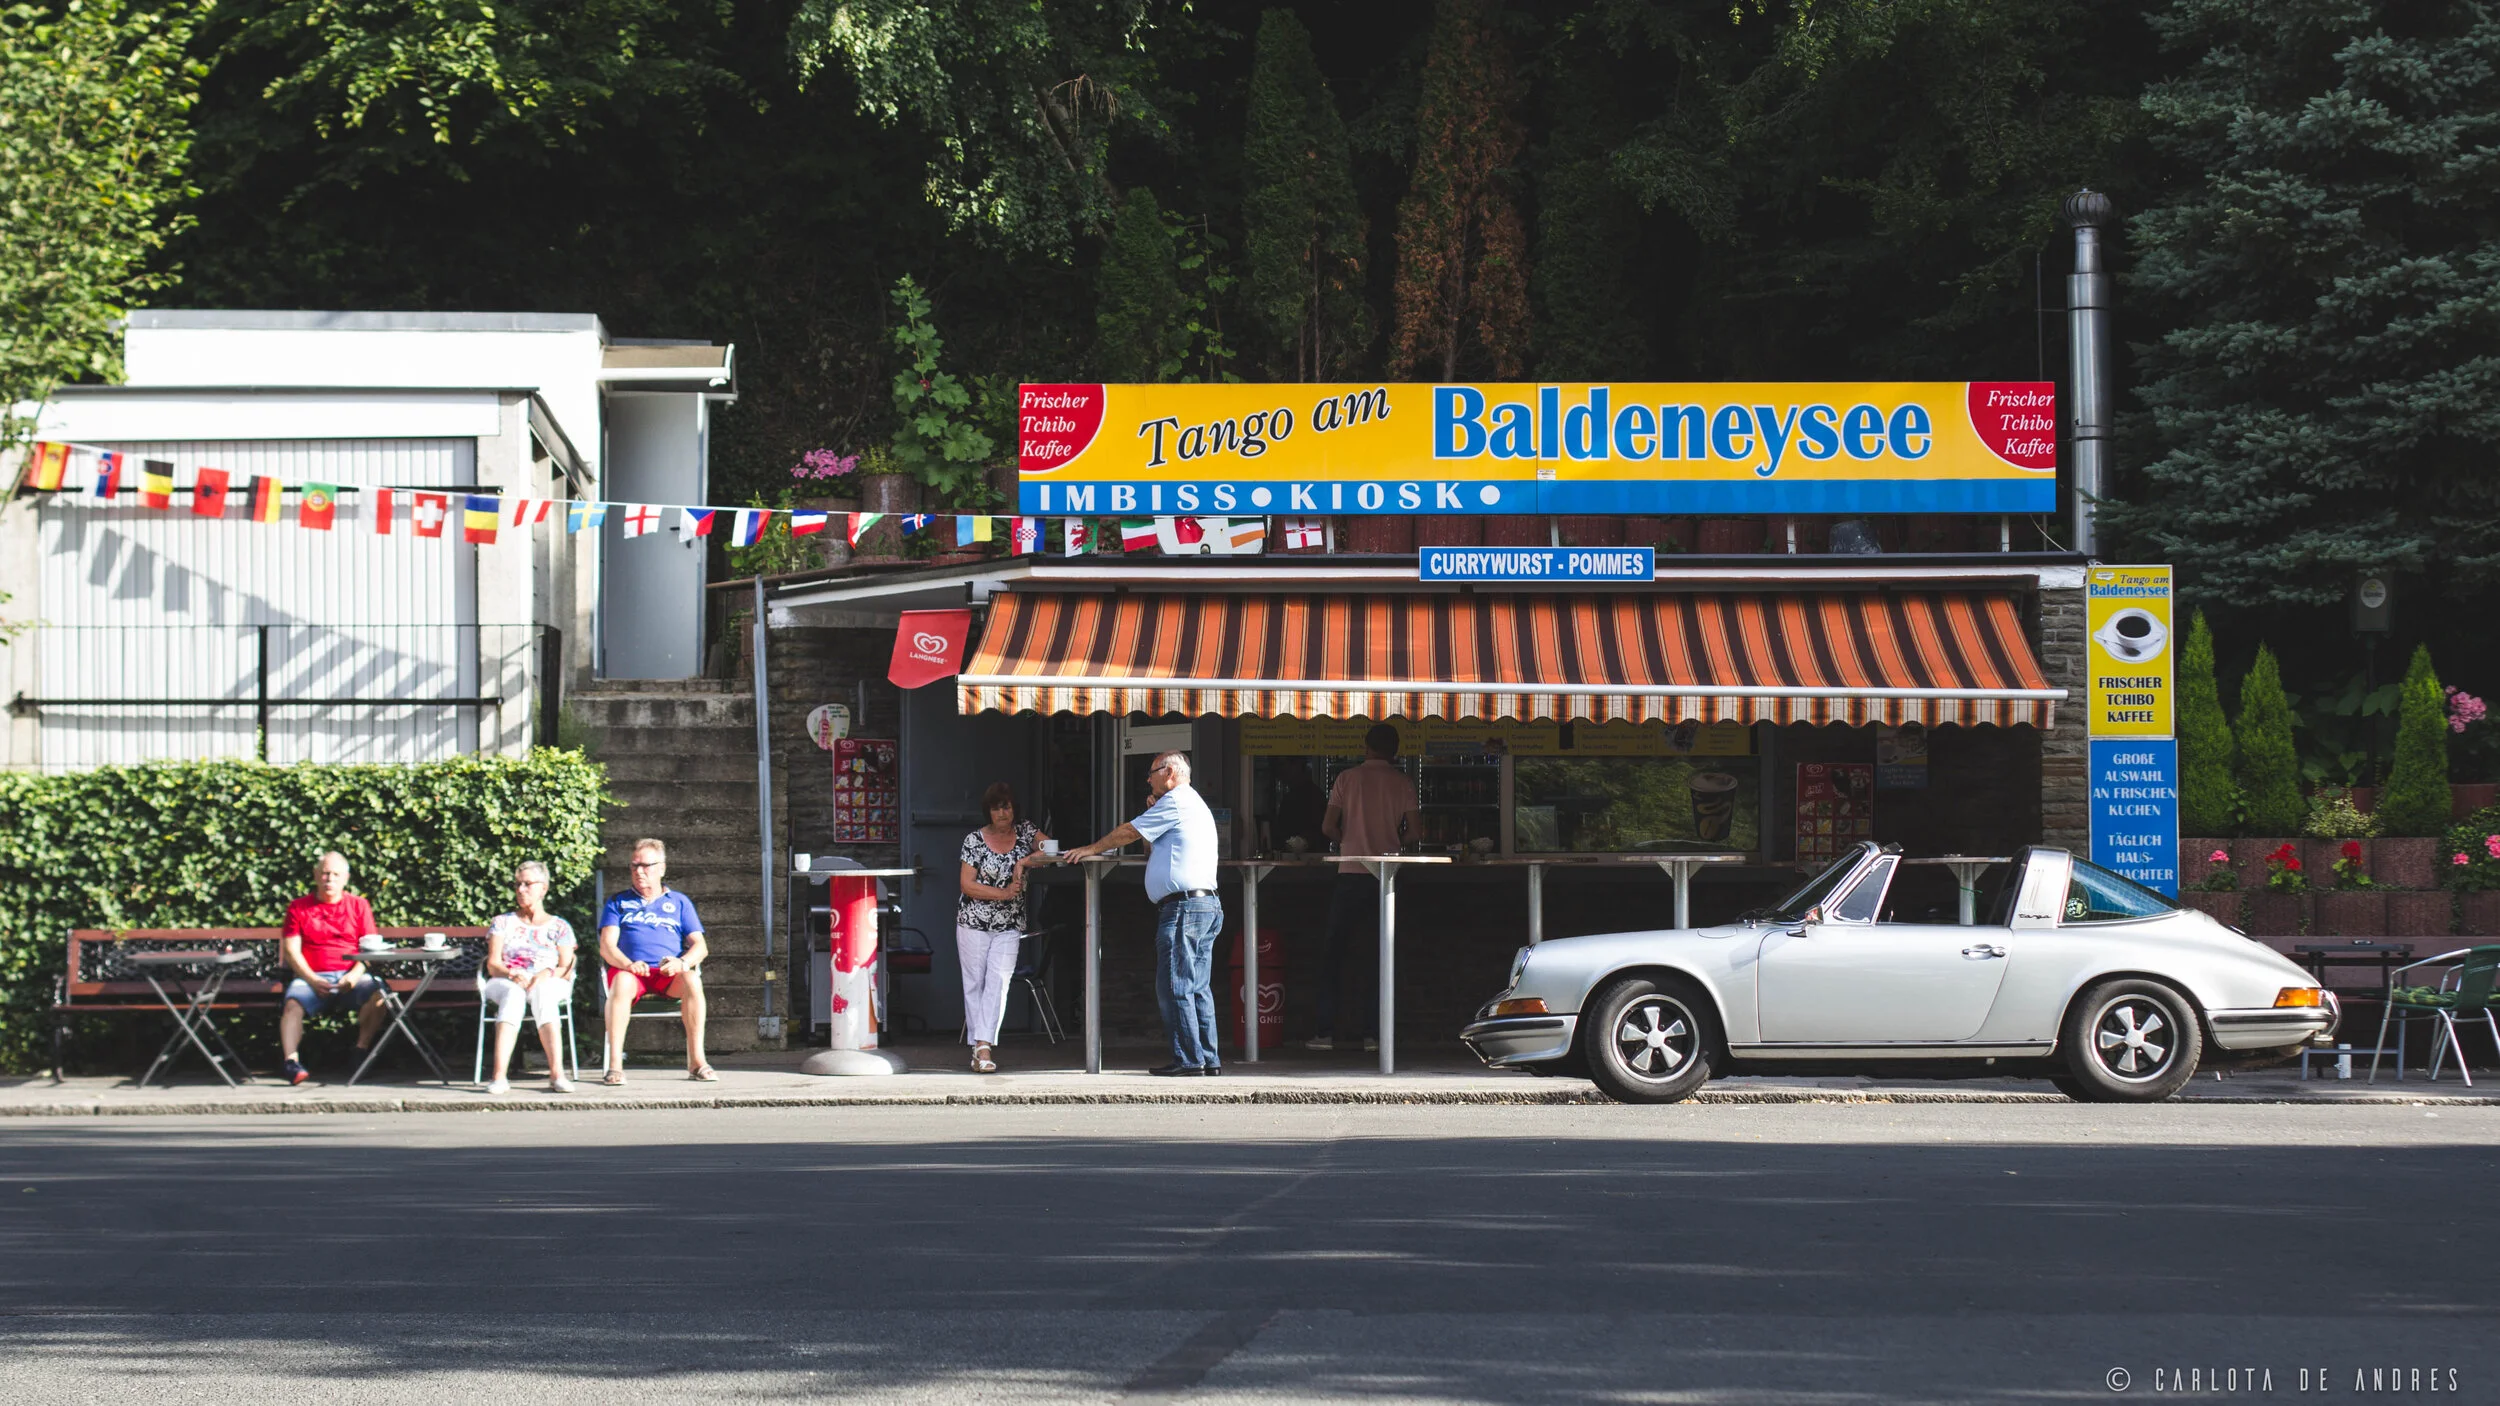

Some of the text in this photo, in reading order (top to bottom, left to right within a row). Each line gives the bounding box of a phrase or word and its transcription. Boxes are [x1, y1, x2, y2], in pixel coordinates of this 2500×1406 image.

[1021, 391, 1089, 409] Frischer
[1986, 390, 2054, 408] Frischer
[1022, 416, 1077, 433] Tchibo
[1139, 387, 1390, 467] Tango am
[2000, 414, 2054, 431] Tchibo
[1433, 386, 1932, 478] Baldeneysee
[1021, 440, 1072, 459] Kaffee
[2004, 438, 2054, 458] Kaffee
[1040, 482, 1464, 511] IMBISS KIOSK
[1430, 553, 1554, 575] CURRYWURST
[1569, 553, 1644, 575] POMMES
[2120, 574, 2150, 585] Tango
[2089, 583, 2169, 597] Baldeneysee
[909, 651, 945, 664] LANGNESE
[2099, 677, 2162, 689] FRISCHER
[2106, 693, 2155, 706] TCHIBO
[2107, 710, 2154, 723] KAFFEE
[2105, 770, 2164, 782] AUSWAHL
[2093, 787, 2176, 799] AN FRISCHEN
[2109, 804, 2161, 816] KUCHEN
[2109, 832, 2162, 847] TÄGLICH
[2116, 852, 2154, 863] HAUS-
